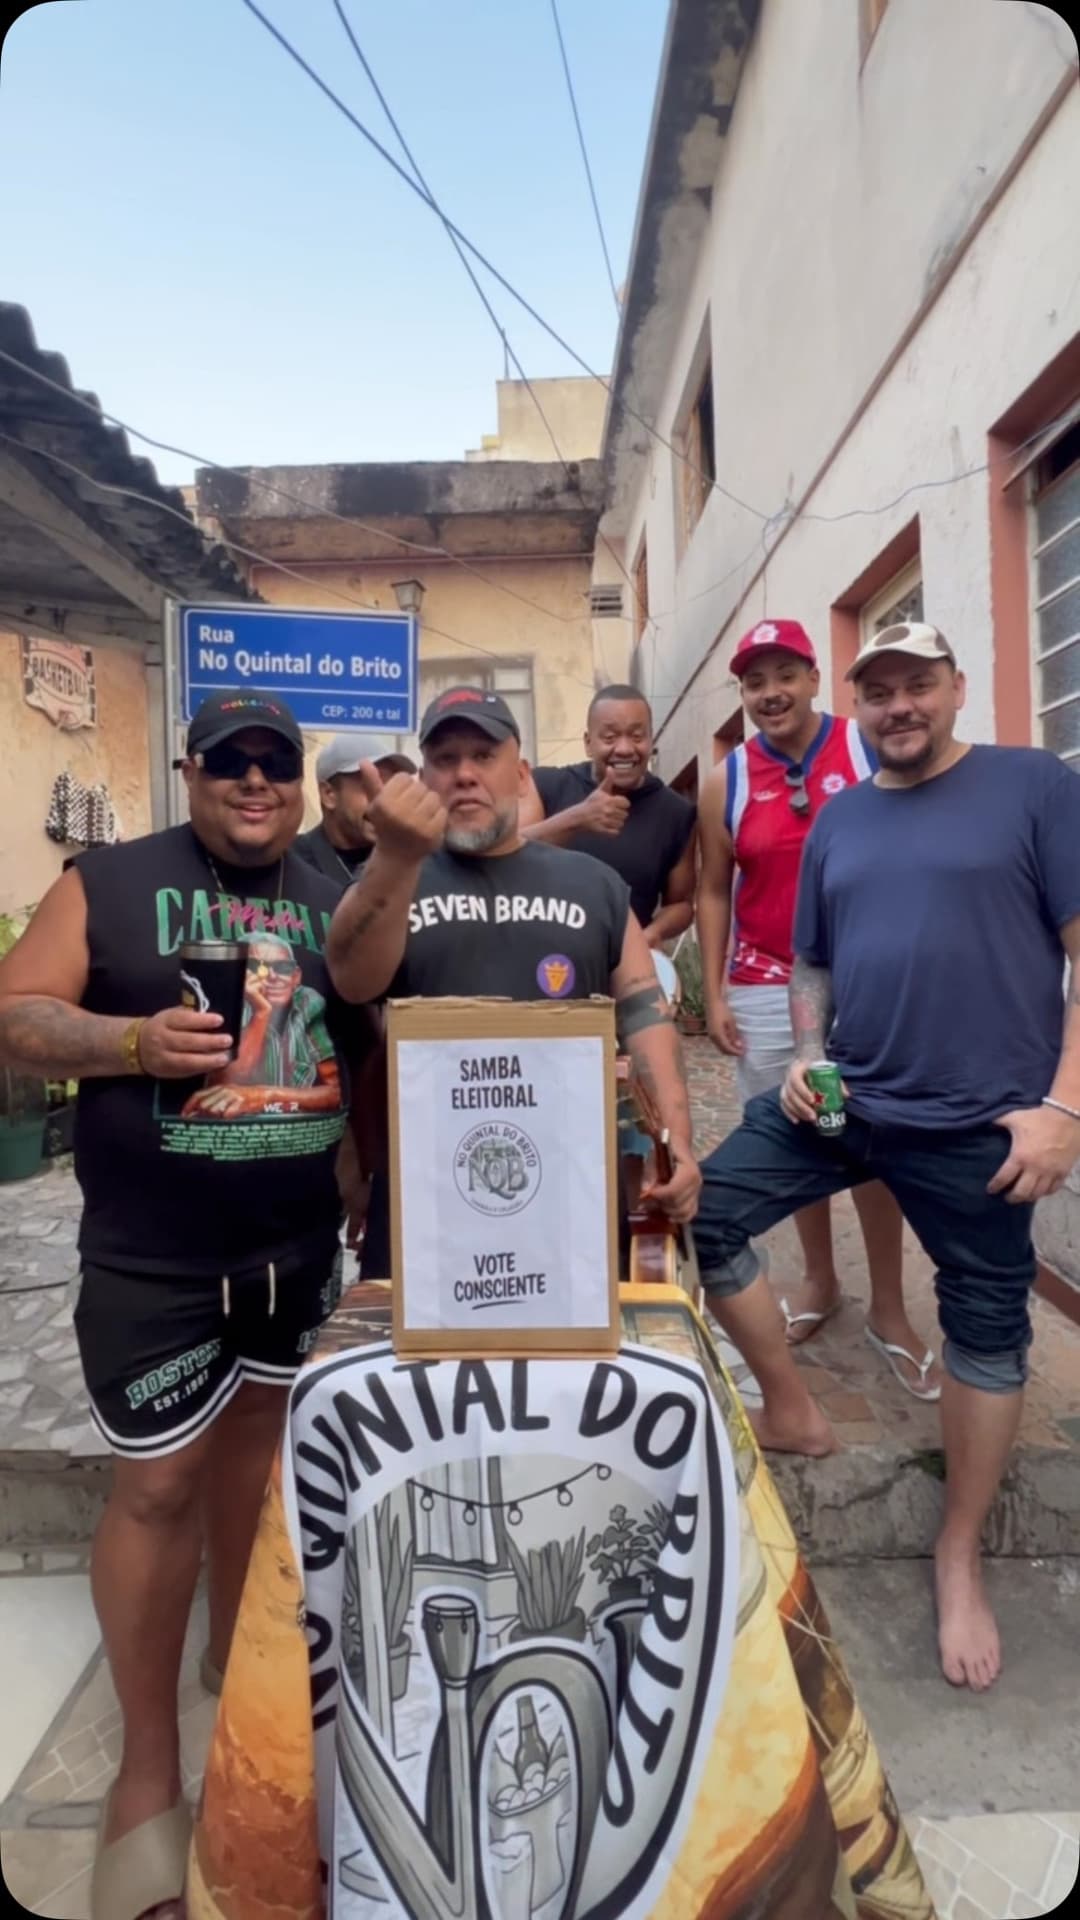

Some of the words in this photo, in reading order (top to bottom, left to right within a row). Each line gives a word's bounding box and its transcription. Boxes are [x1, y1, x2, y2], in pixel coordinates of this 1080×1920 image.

[199, 624, 235, 644] Rua
[199, 649, 228, 671] No
[234, 650, 312, 677] Quintal
[318, 655, 344, 677] do
[351, 656, 402, 679] Brito
[321, 704, 348, 718] CEP:
[351, 705, 373, 719] 200
[375, 708, 383, 720] e
[407, 894, 488, 934] SEVEN
[495, 895, 586, 930] BRAND
[460, 1055, 522, 1082] SAMBA
[451, 1084, 538, 1110] ELEITORAL
[462, 1125, 500, 1151] QUINTAL
[502, 1126, 518, 1140] DO
[457, 1152, 468, 1168] NO
[516, 1136, 537, 1168] BRITO
[473, 1252, 516, 1277] VOTE
[454, 1273, 547, 1303] CONSCIENTE
[296, 1360, 550, 1572] QUINTAL
[578, 1362, 698, 1470] DO
